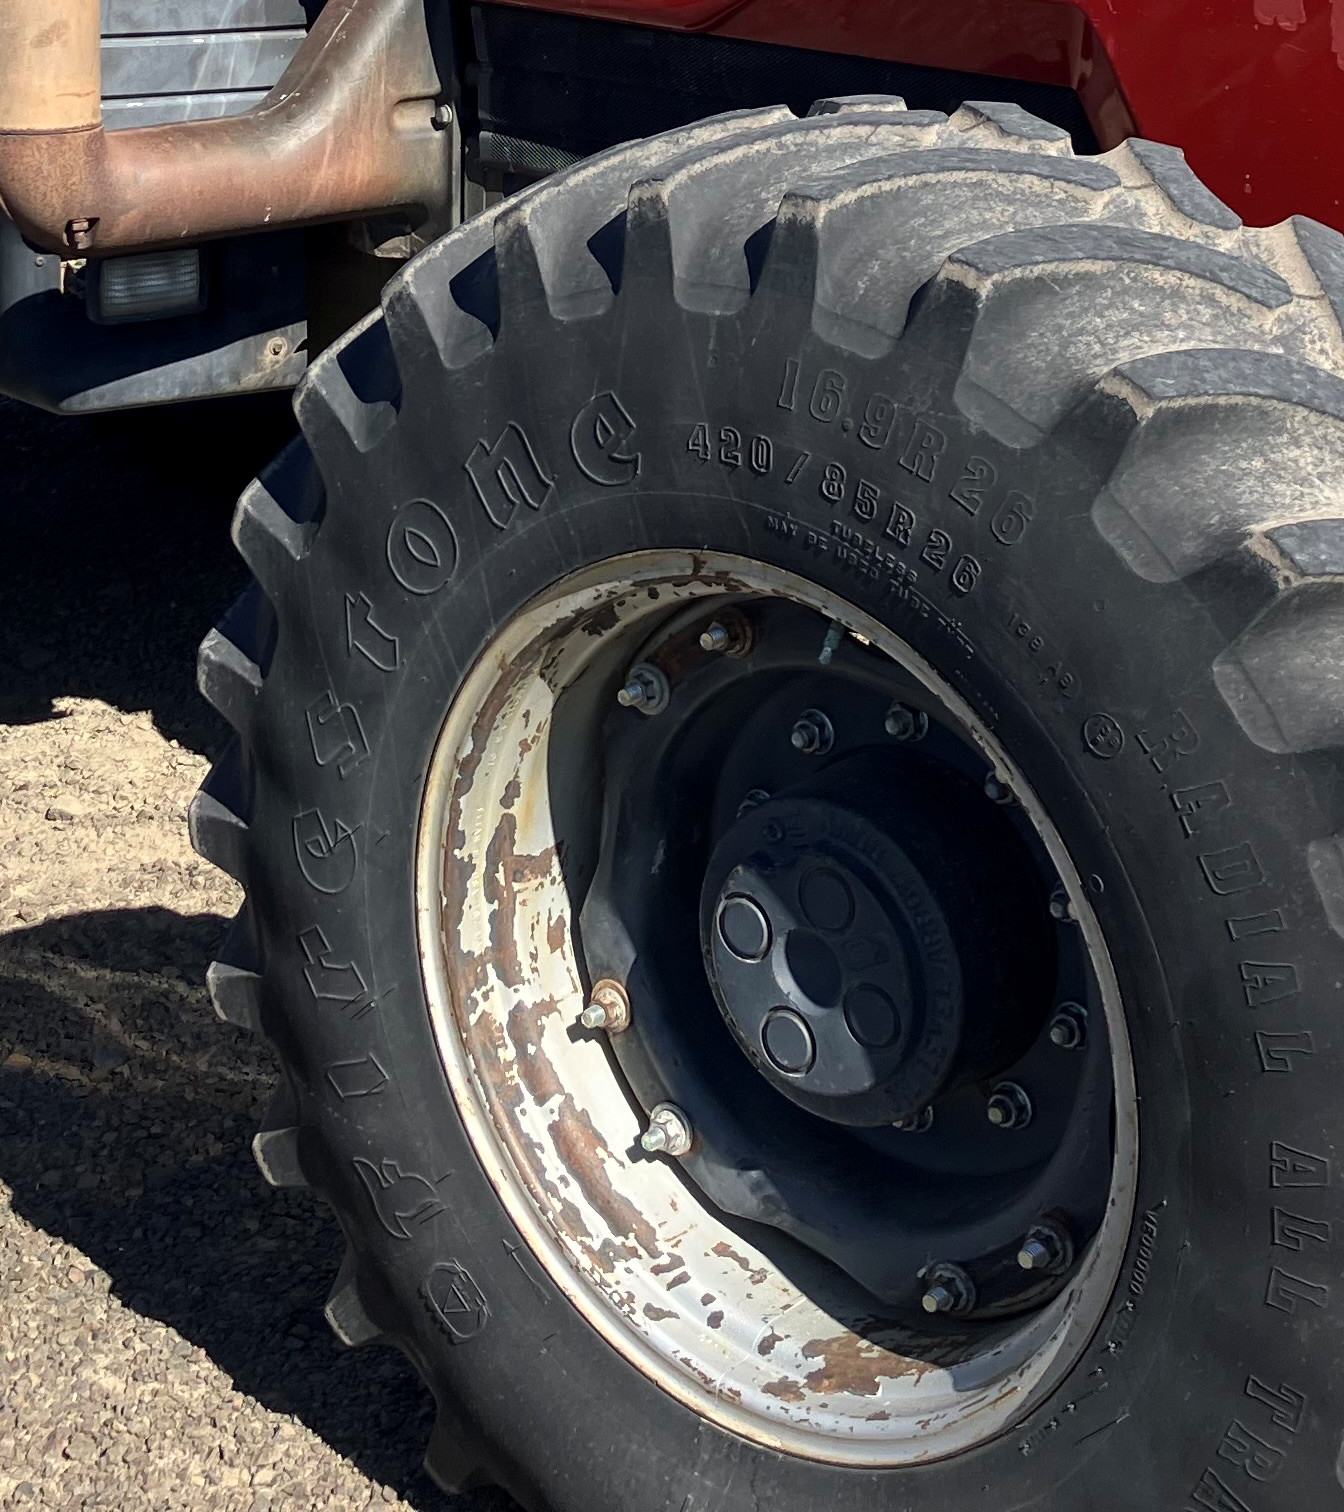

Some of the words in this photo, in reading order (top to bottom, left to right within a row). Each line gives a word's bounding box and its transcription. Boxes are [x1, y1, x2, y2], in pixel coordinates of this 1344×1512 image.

[294, 391, 644, 1240] Firestone
[1136, 707, 1316, 1075] RADIAL
[1265, 1139, 1333, 1317] ALL
